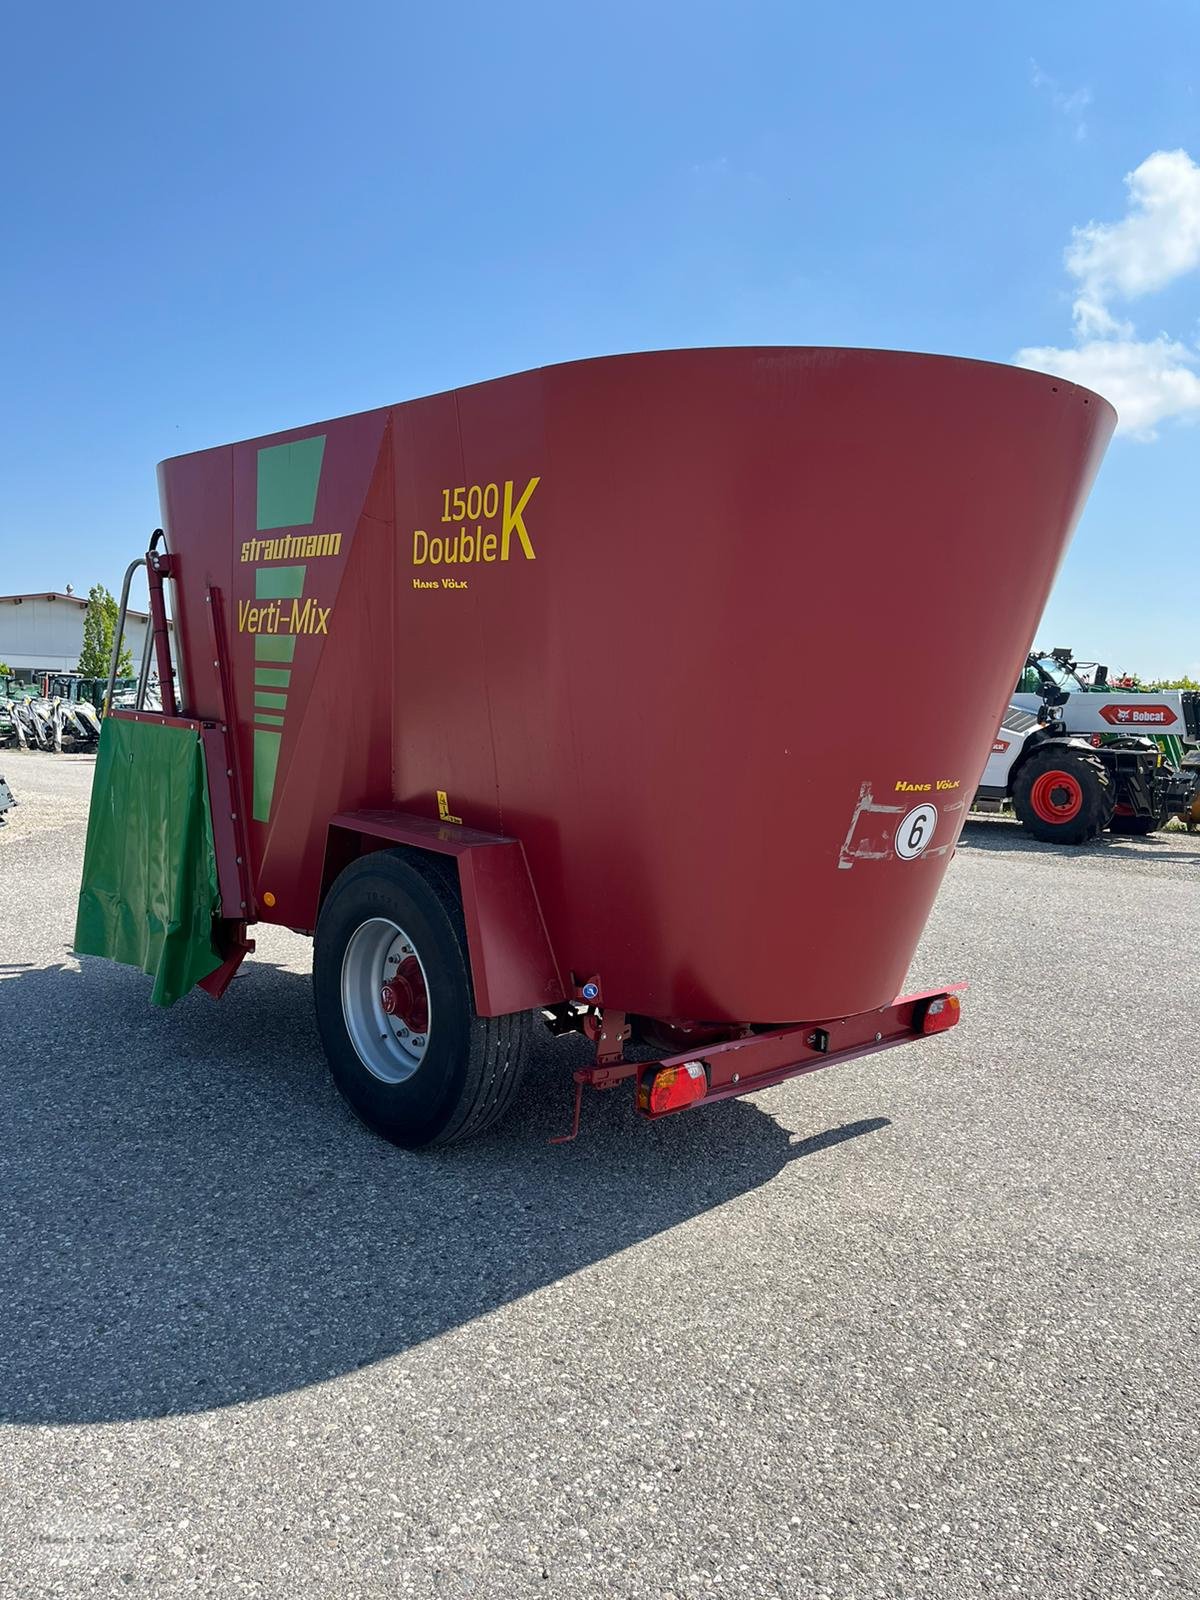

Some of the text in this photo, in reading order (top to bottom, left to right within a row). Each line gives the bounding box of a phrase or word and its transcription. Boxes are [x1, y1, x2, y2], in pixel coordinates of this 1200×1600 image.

[441, 482, 499, 522] 1500
[501, 476, 541, 561] K
[240, 533, 342, 562] strautmann
[413, 525, 497, 565] Double
[238, 598, 331, 635] Verti-Mix
[1132, 711, 1165, 721] Bobcat
[907, 814, 927, 849] 6
